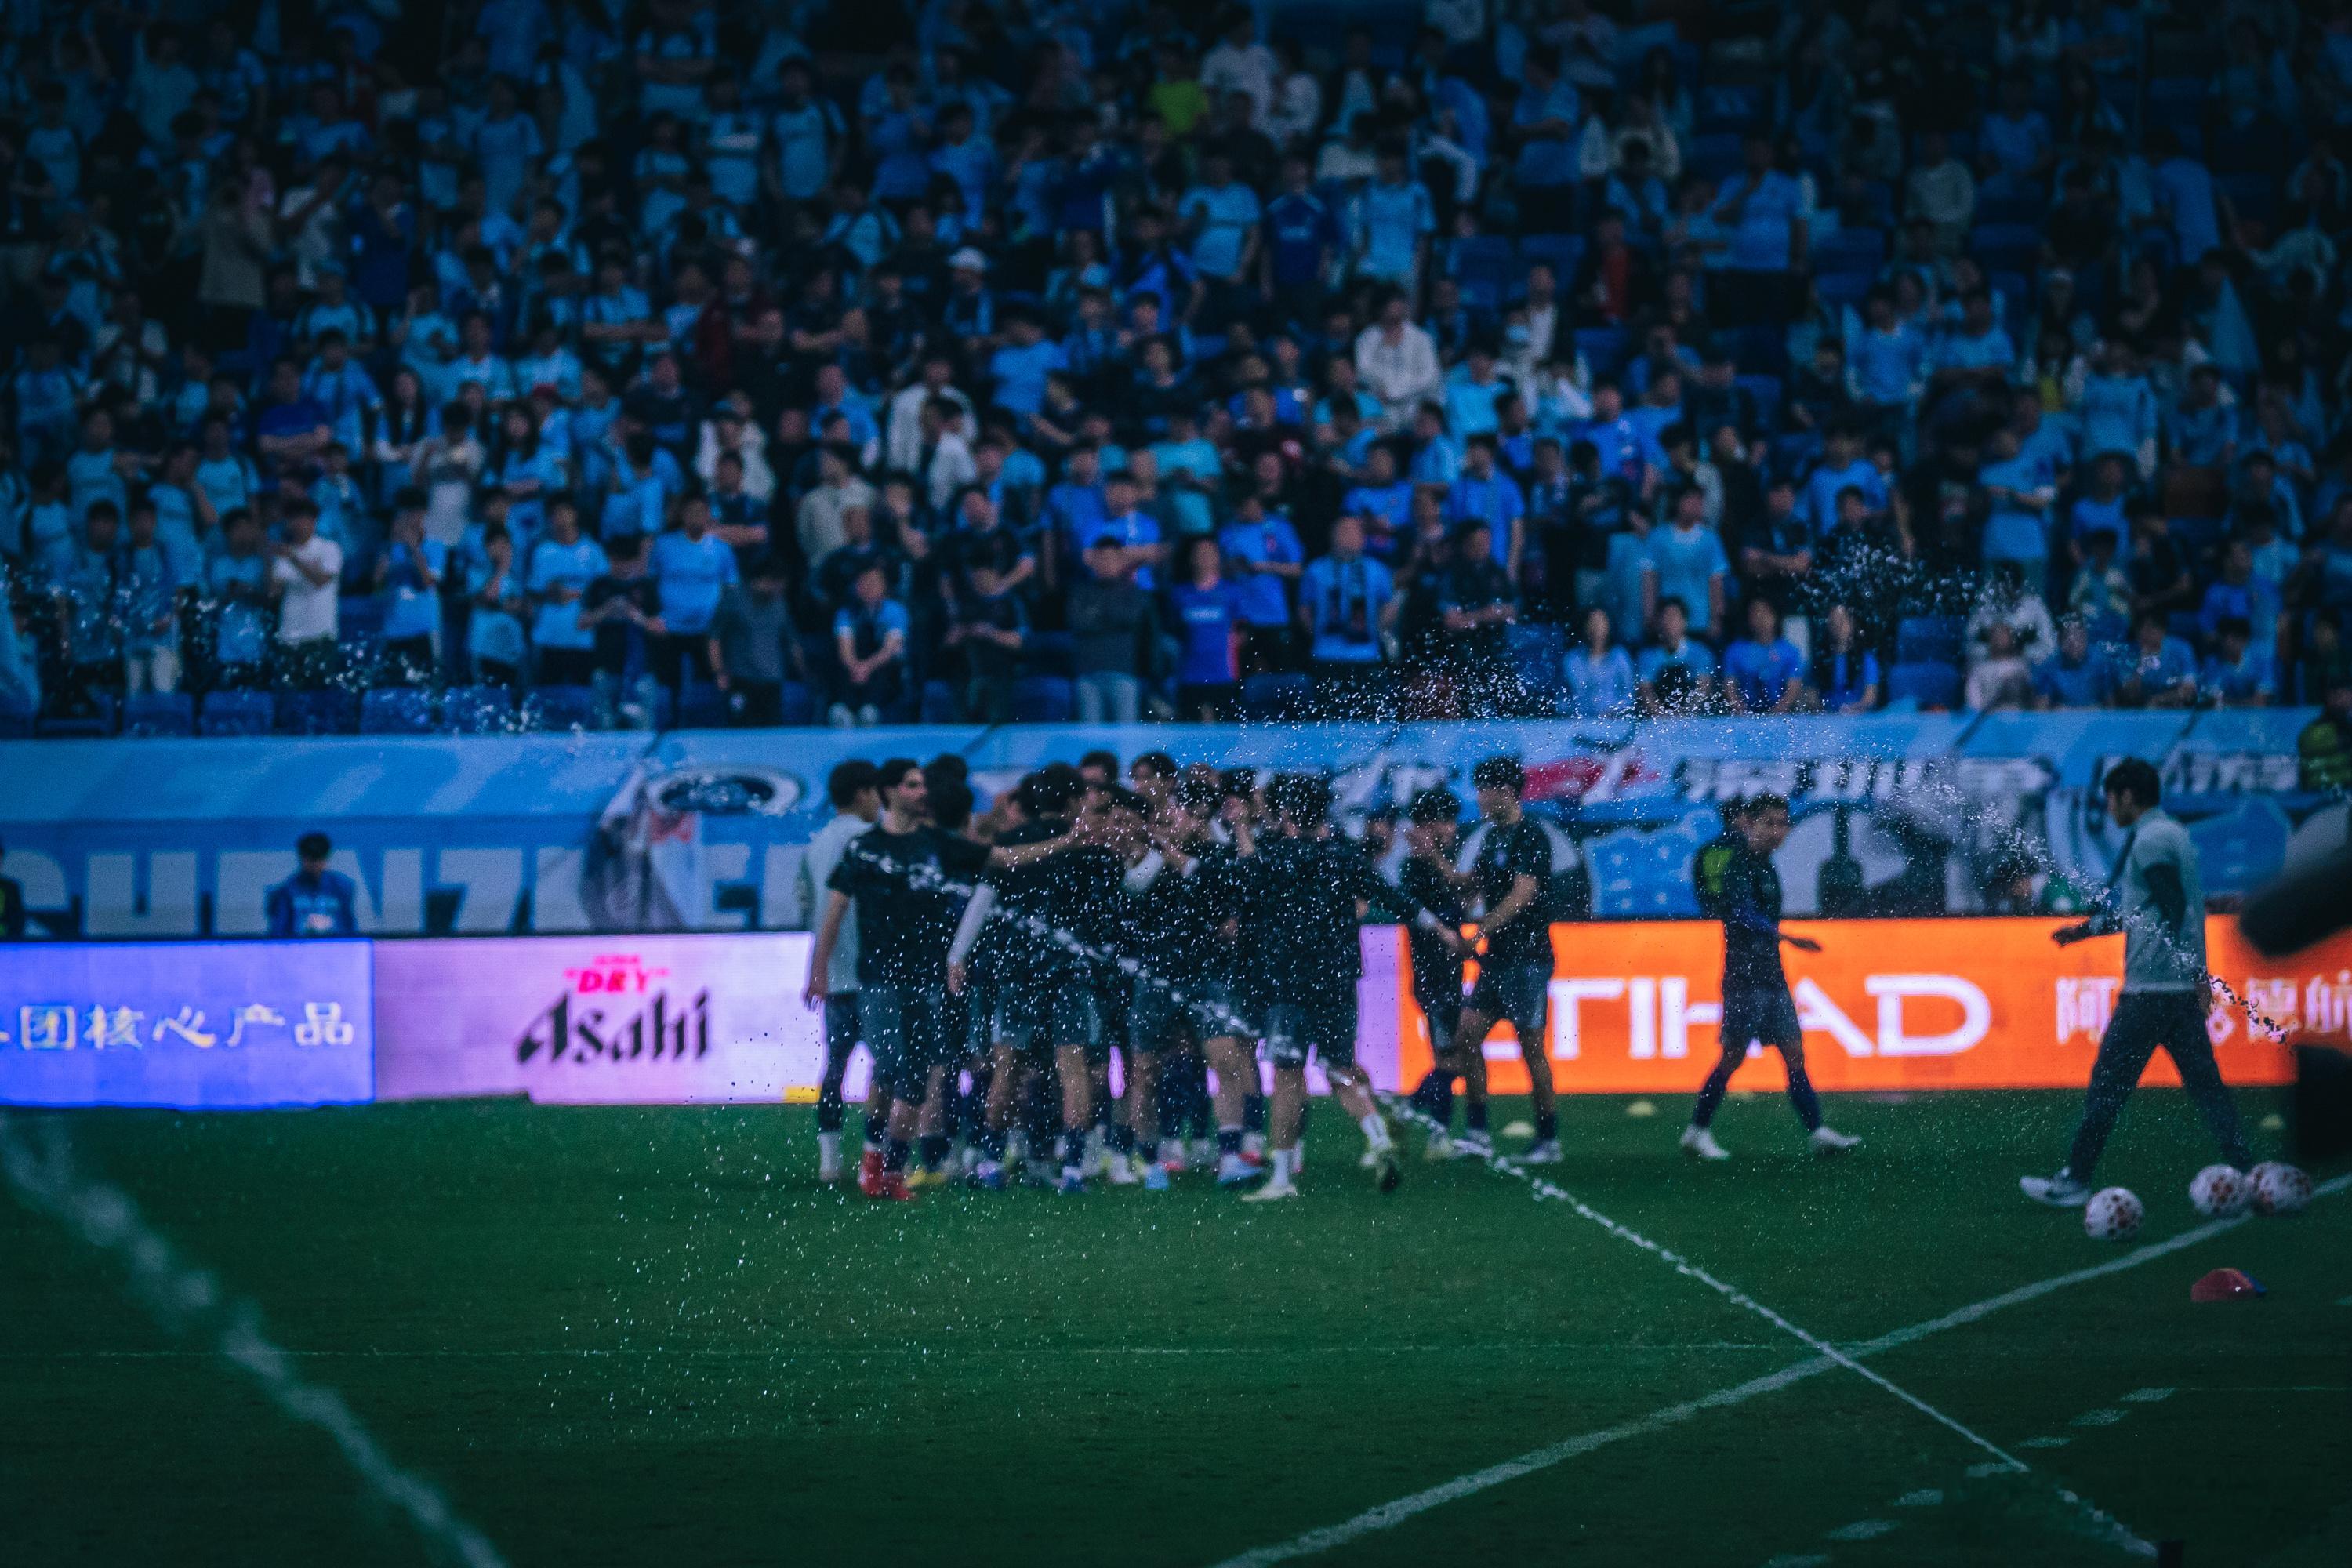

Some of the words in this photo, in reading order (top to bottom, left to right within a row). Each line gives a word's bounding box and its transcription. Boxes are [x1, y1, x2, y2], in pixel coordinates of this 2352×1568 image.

[0, 1002, 354, 1051] 团核心产品
[517, 989, 709, 1062] Asahi
[1416, 977, 1991, 1059] TIHAD
